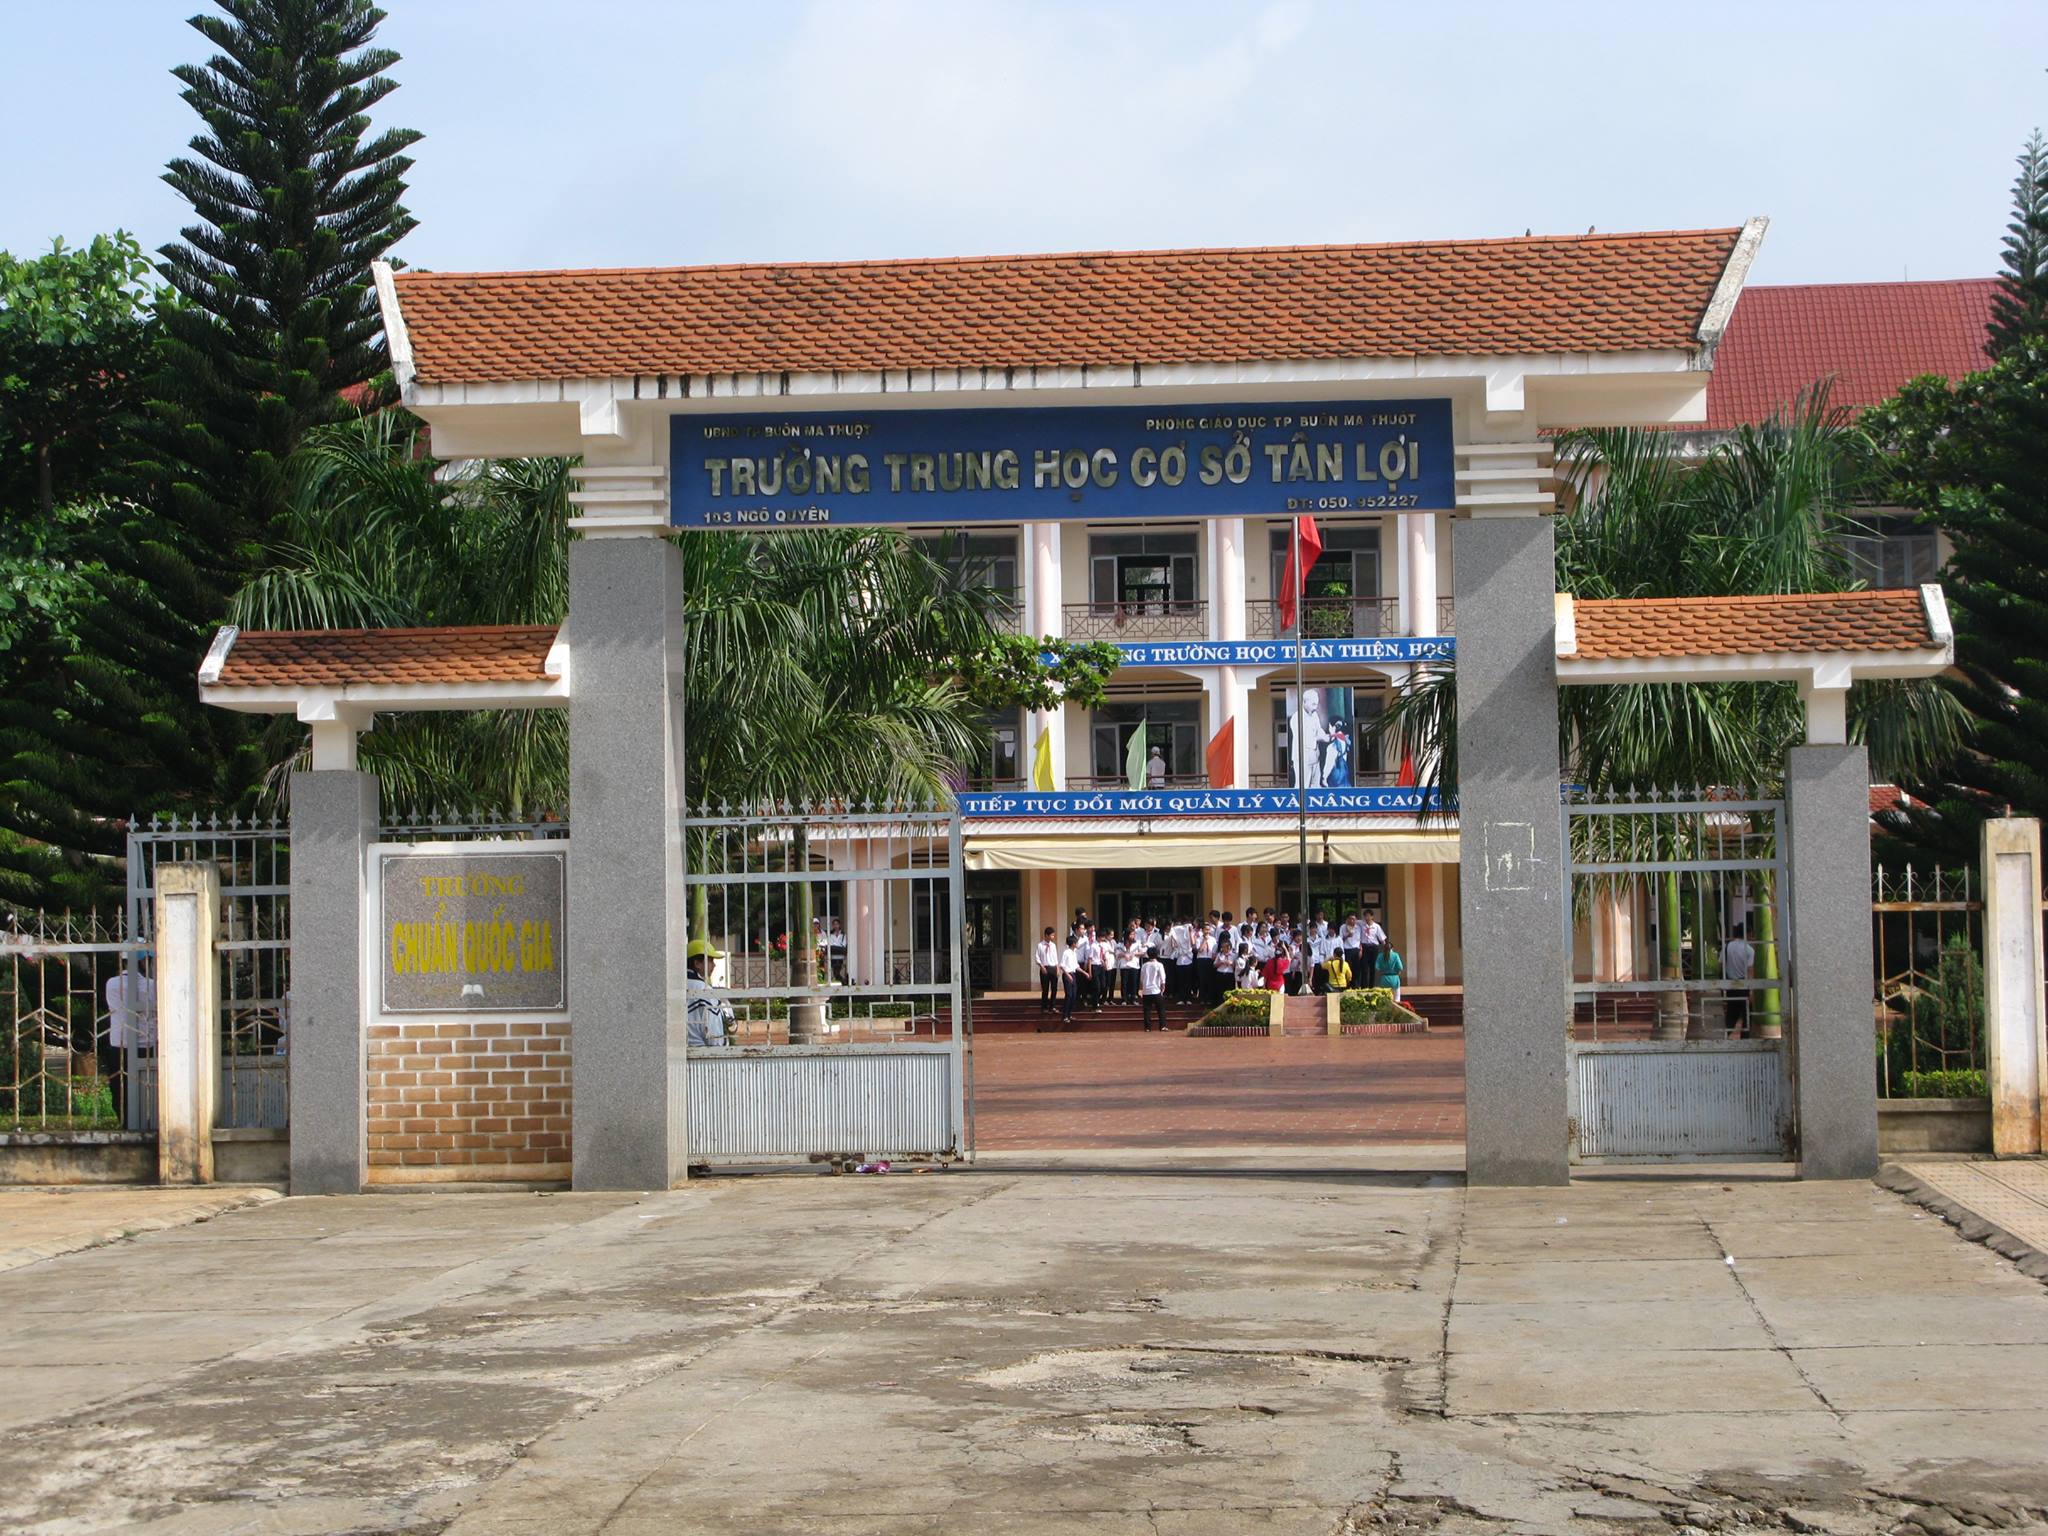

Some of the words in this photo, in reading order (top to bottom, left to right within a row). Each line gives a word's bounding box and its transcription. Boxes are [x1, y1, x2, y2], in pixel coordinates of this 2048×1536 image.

[765, 423, 800, 437] BUÔN
[805, 425, 824, 437] MA
[828, 422, 871, 439] THUỘT
[1238, 417, 1267, 432] DỤC
[1274, 416, 1292, 427] TP
[1300, 412, 1338, 427] BUÔN
[1344, 415, 1363, 426] MA
[704, 443, 870, 497] TRƯỜNG
[883, 449, 1020, 492] TRUNG
[1034, 448, 1119, 502] HỌC
[1130, 440, 1187, 487] CƠ
[1199, 430, 1252, 486] SỞ
[1264, 431, 1344, 482] TÂN
[1356, 433, 1419, 493] LỢI
[1319, 496, 1352, 508] 050.
[1358, 494, 1419, 508] 952227
[737, 507, 770, 522] NGÔ
[1151, 645, 1230, 663] TRƯỜNG
[1235, 647, 1276, 662] HỌC
[1281, 641, 1334, 659] THÂN
[1339, 640, 1404, 660] THIỆN,
[966, 794, 1017, 811] TIẾP
[1023, 799, 1067, 813] TỤC
[1073, 794, 1112, 811] ĐỔI
[1119, 795, 1162, 810] MỚI
[1169, 793, 1230, 809] QUẢN
[1237, 793, 1264, 808] LÝ
[1272, 793, 1300, 808] VÀ
[1308, 791, 1370, 807] NÂNG
[1377, 795, 1422, 807] CAO
[391, 902, 458, 975] CHUẨN
[463, 903, 515, 975] QUỐC
[520, 919, 554, 974] GIA
